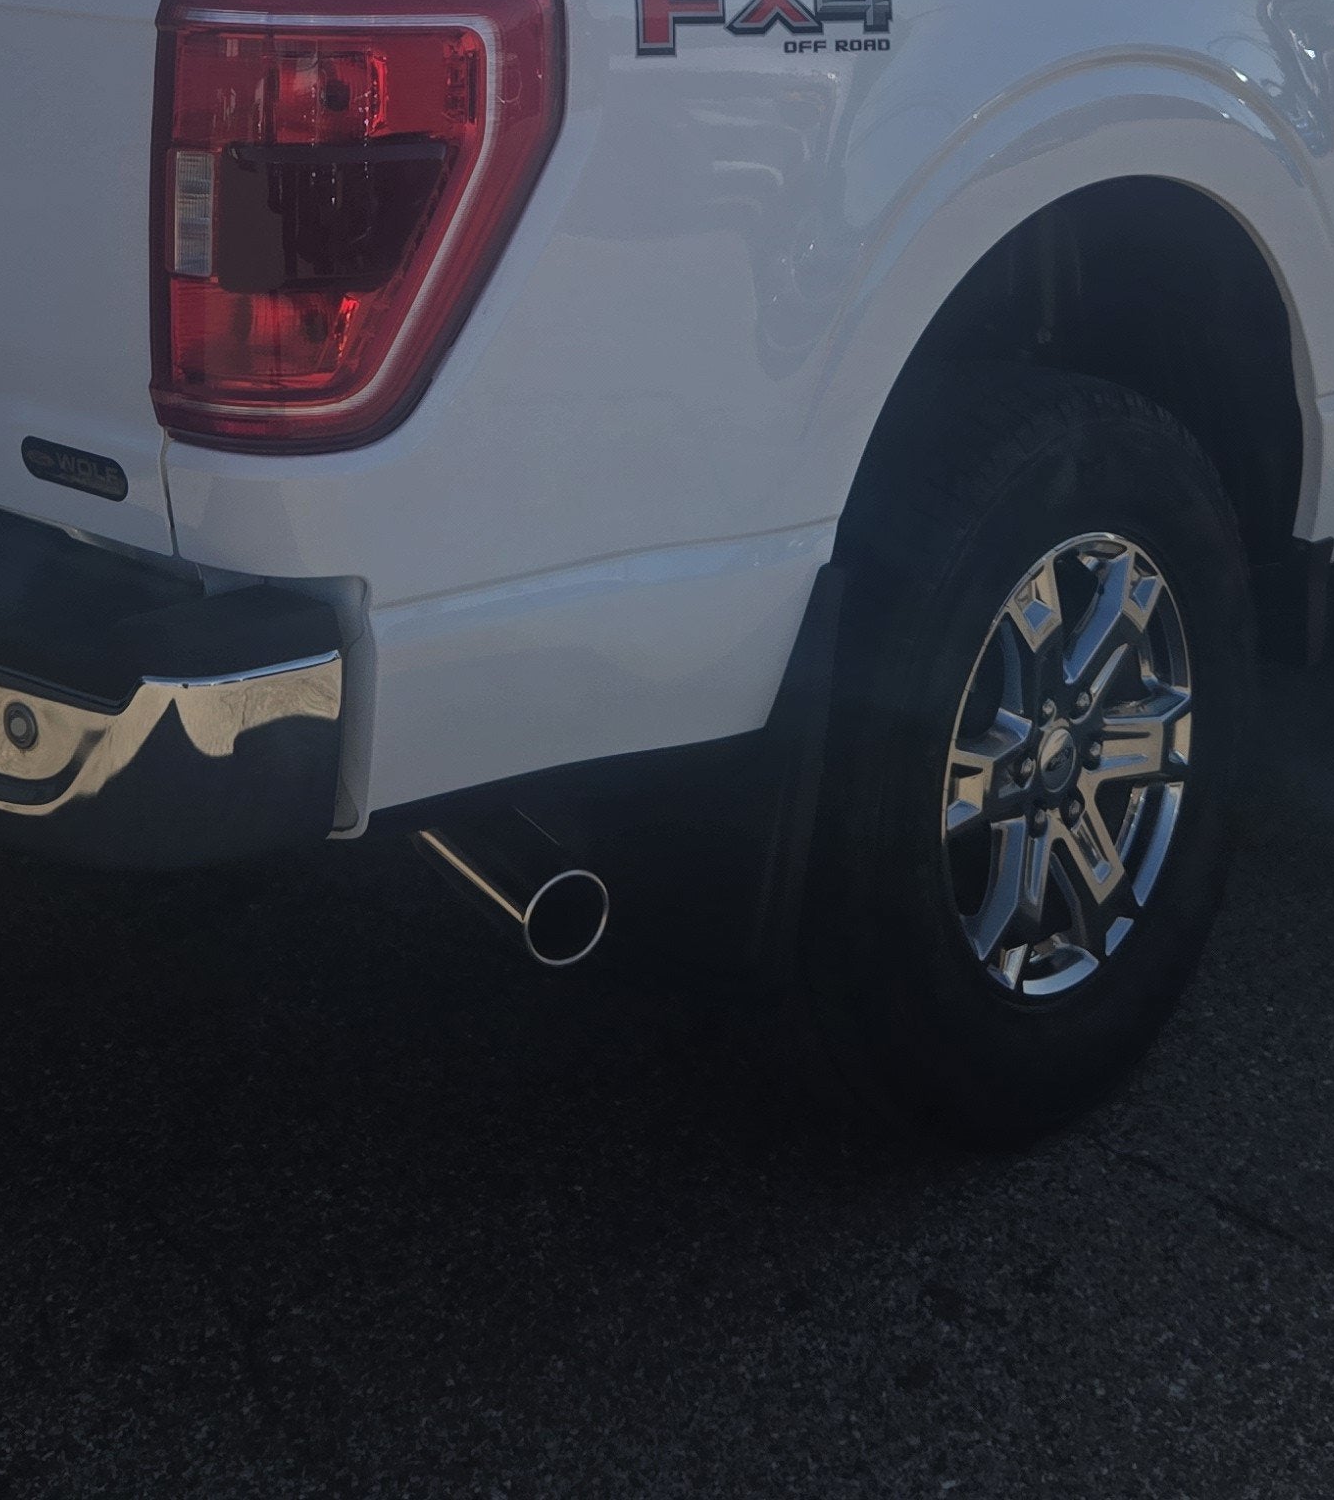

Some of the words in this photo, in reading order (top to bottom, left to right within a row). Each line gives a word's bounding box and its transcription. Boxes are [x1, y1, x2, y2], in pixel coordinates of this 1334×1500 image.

[783, 39, 827, 54] OFF
[835, 38, 891, 53] ROAD
[55, 452, 119, 485] WOLF
